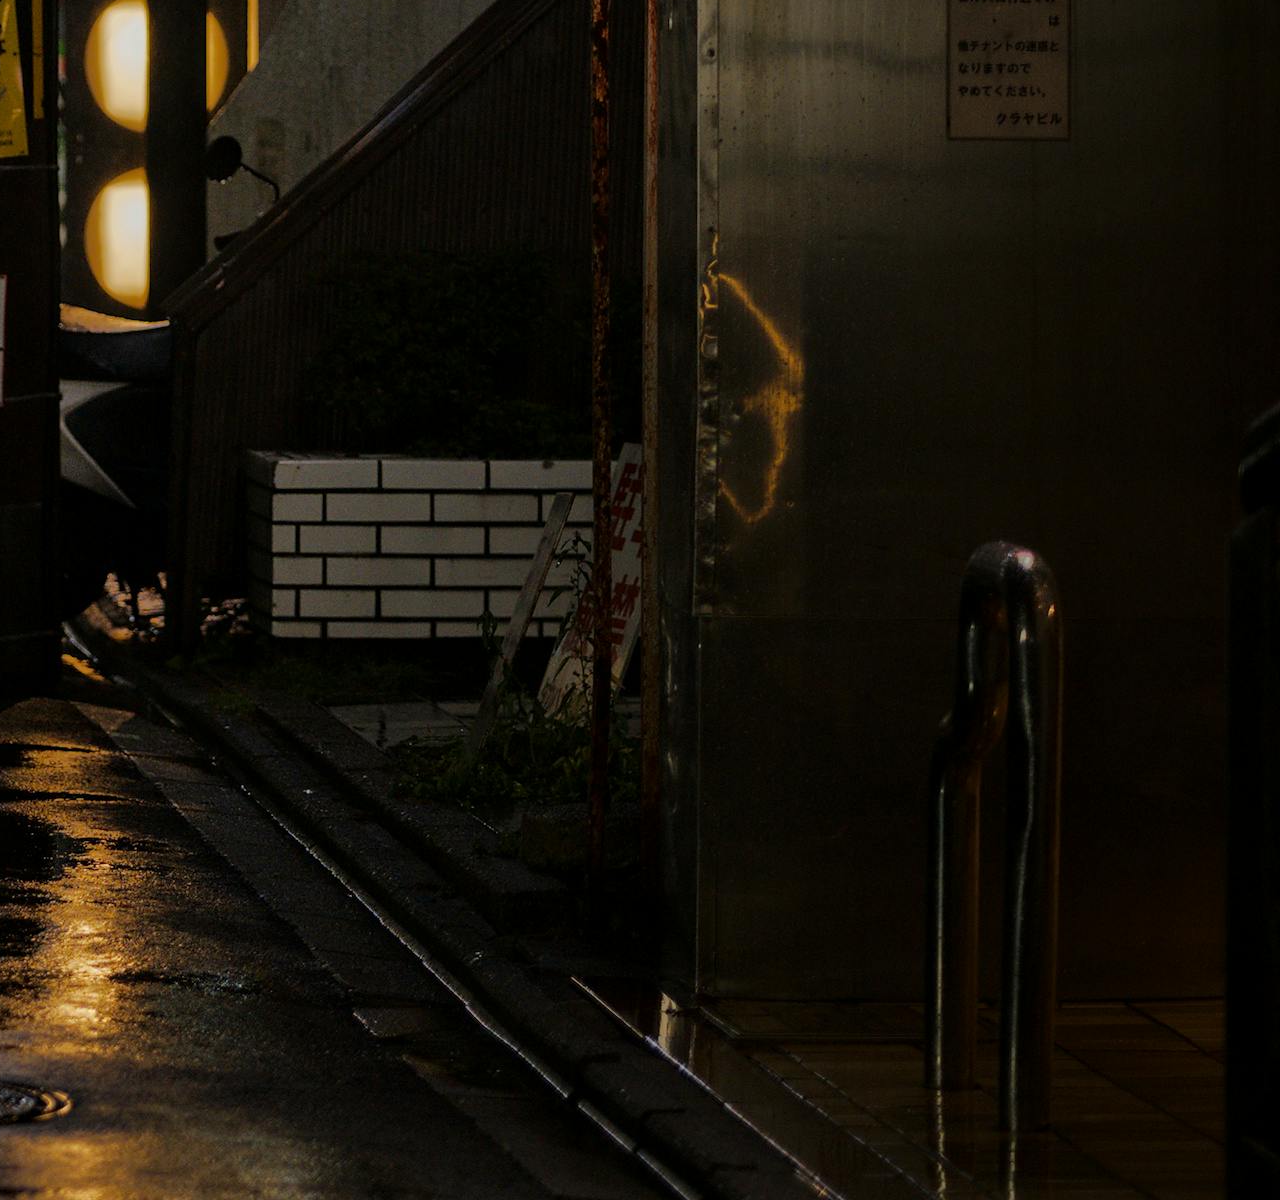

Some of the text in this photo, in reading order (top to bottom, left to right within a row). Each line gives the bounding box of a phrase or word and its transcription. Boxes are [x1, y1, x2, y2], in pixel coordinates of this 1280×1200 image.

[958, 62, 1032, 74] なりますので
